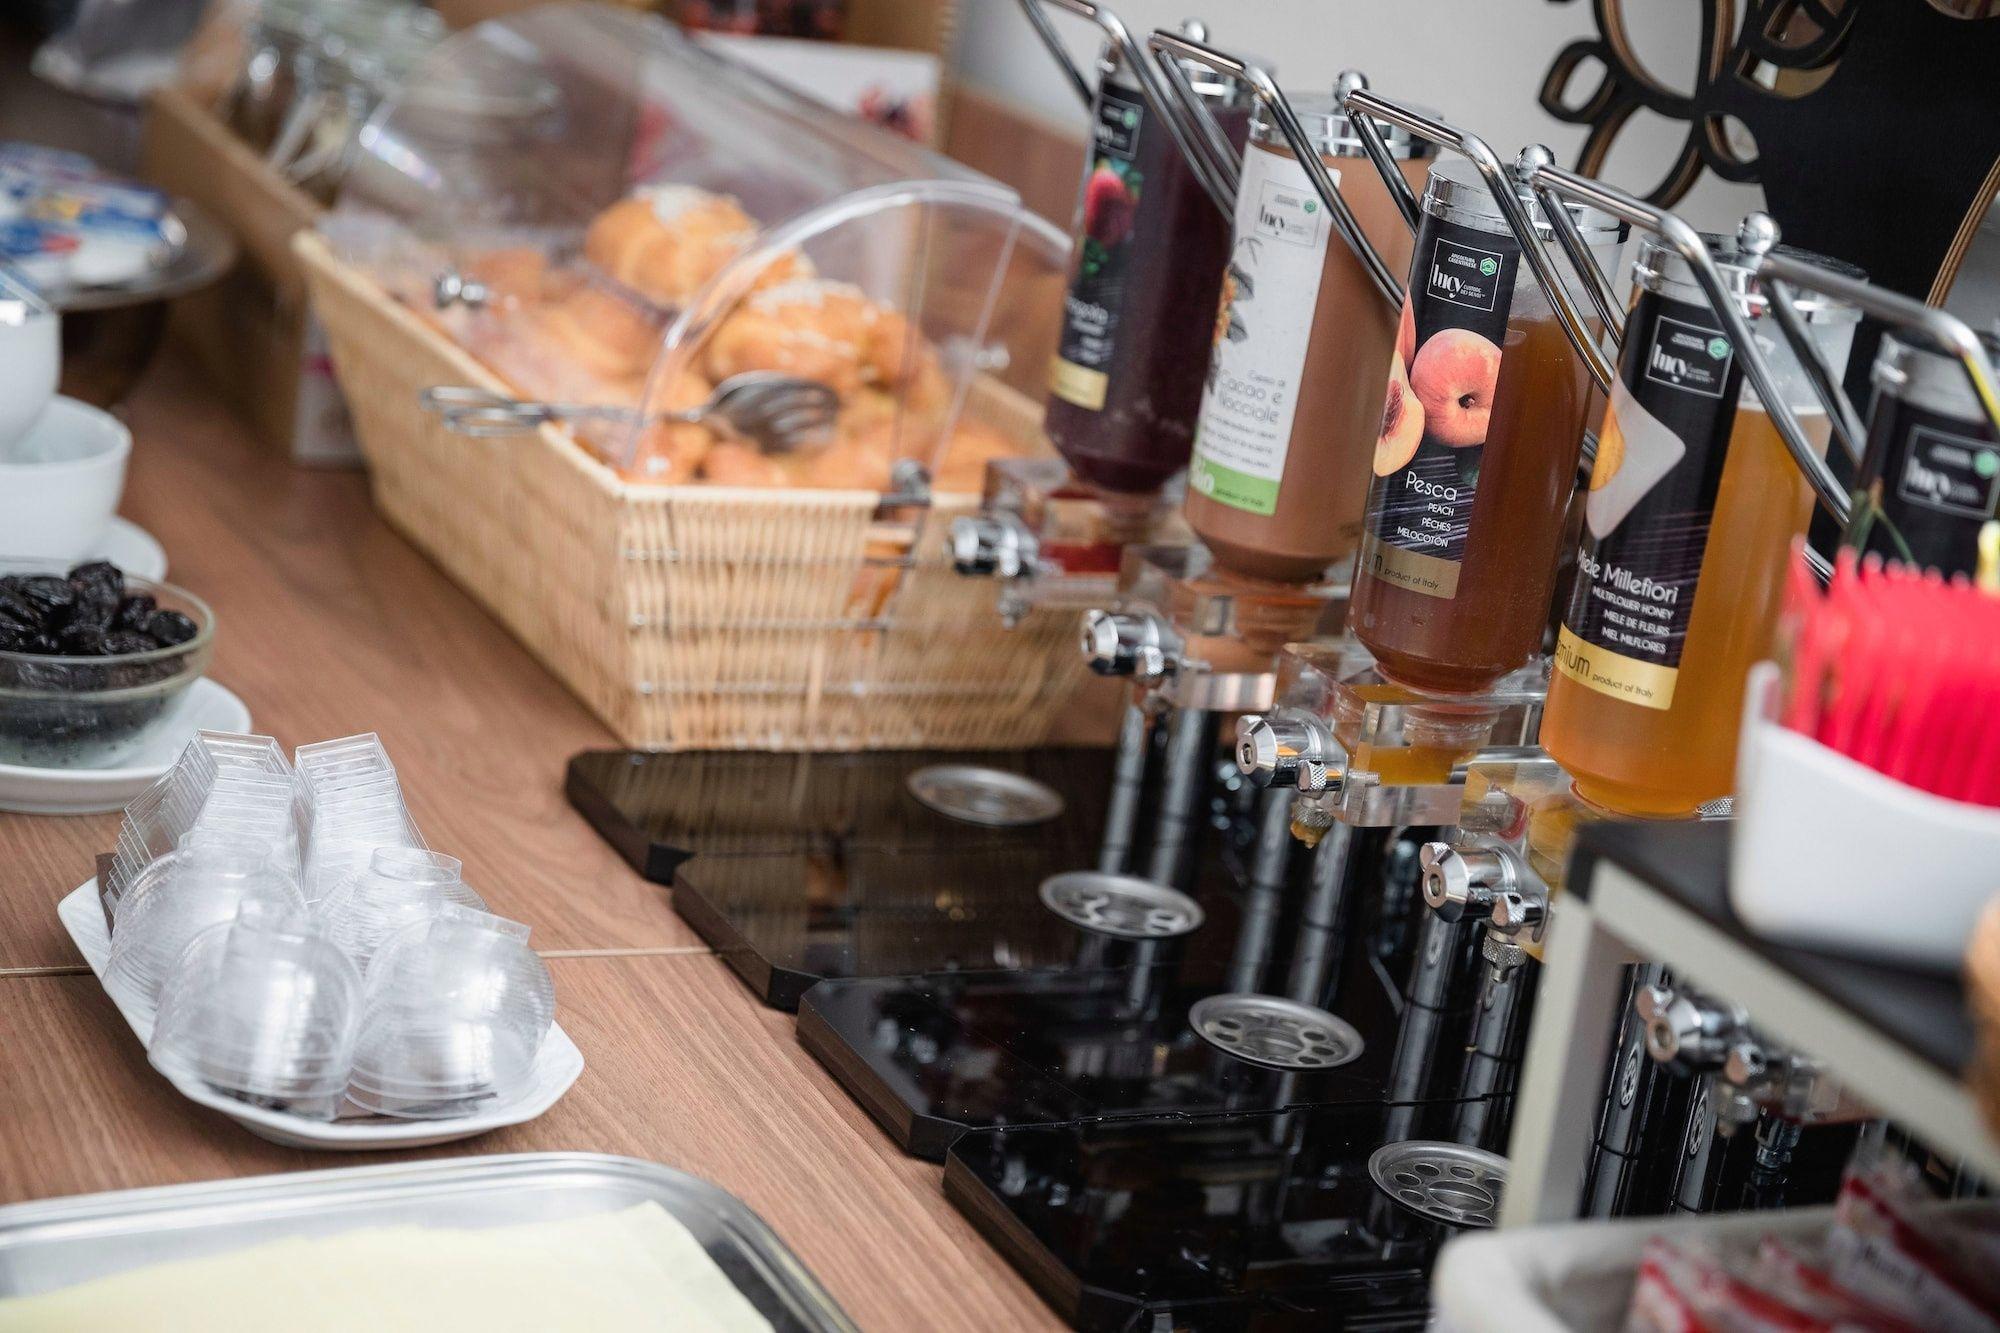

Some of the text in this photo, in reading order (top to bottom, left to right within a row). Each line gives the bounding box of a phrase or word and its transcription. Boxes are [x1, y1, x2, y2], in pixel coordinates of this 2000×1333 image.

[1433, 264, 1465, 298] lucy
[1653, 344, 1689, 383] lucy
[1271, 391, 1284, 406] e
[1406, 470, 1457, 501] Pesca
[1428, 503, 1454, 516] PEACH
[1421, 517, 1451, 532] PÊCHES
[1384, 567, 1411, 581] product
[1412, 577, 1421, 585] of
[1422, 578, 1439, 590] Italy
[1603, 563, 1679, 604] Millefiori
[1593, 586, 1675, 620] MULTIFLOWER HONEY
[1603, 609, 1670, 637] MIELE DE FLEURS
[1601, 626, 1667, 655] MIEL MILFLORES
[1592, 673, 1622, 689] product
[1625, 684, 1634, 693] of
[1636, 686, 1654, 698] Italy
